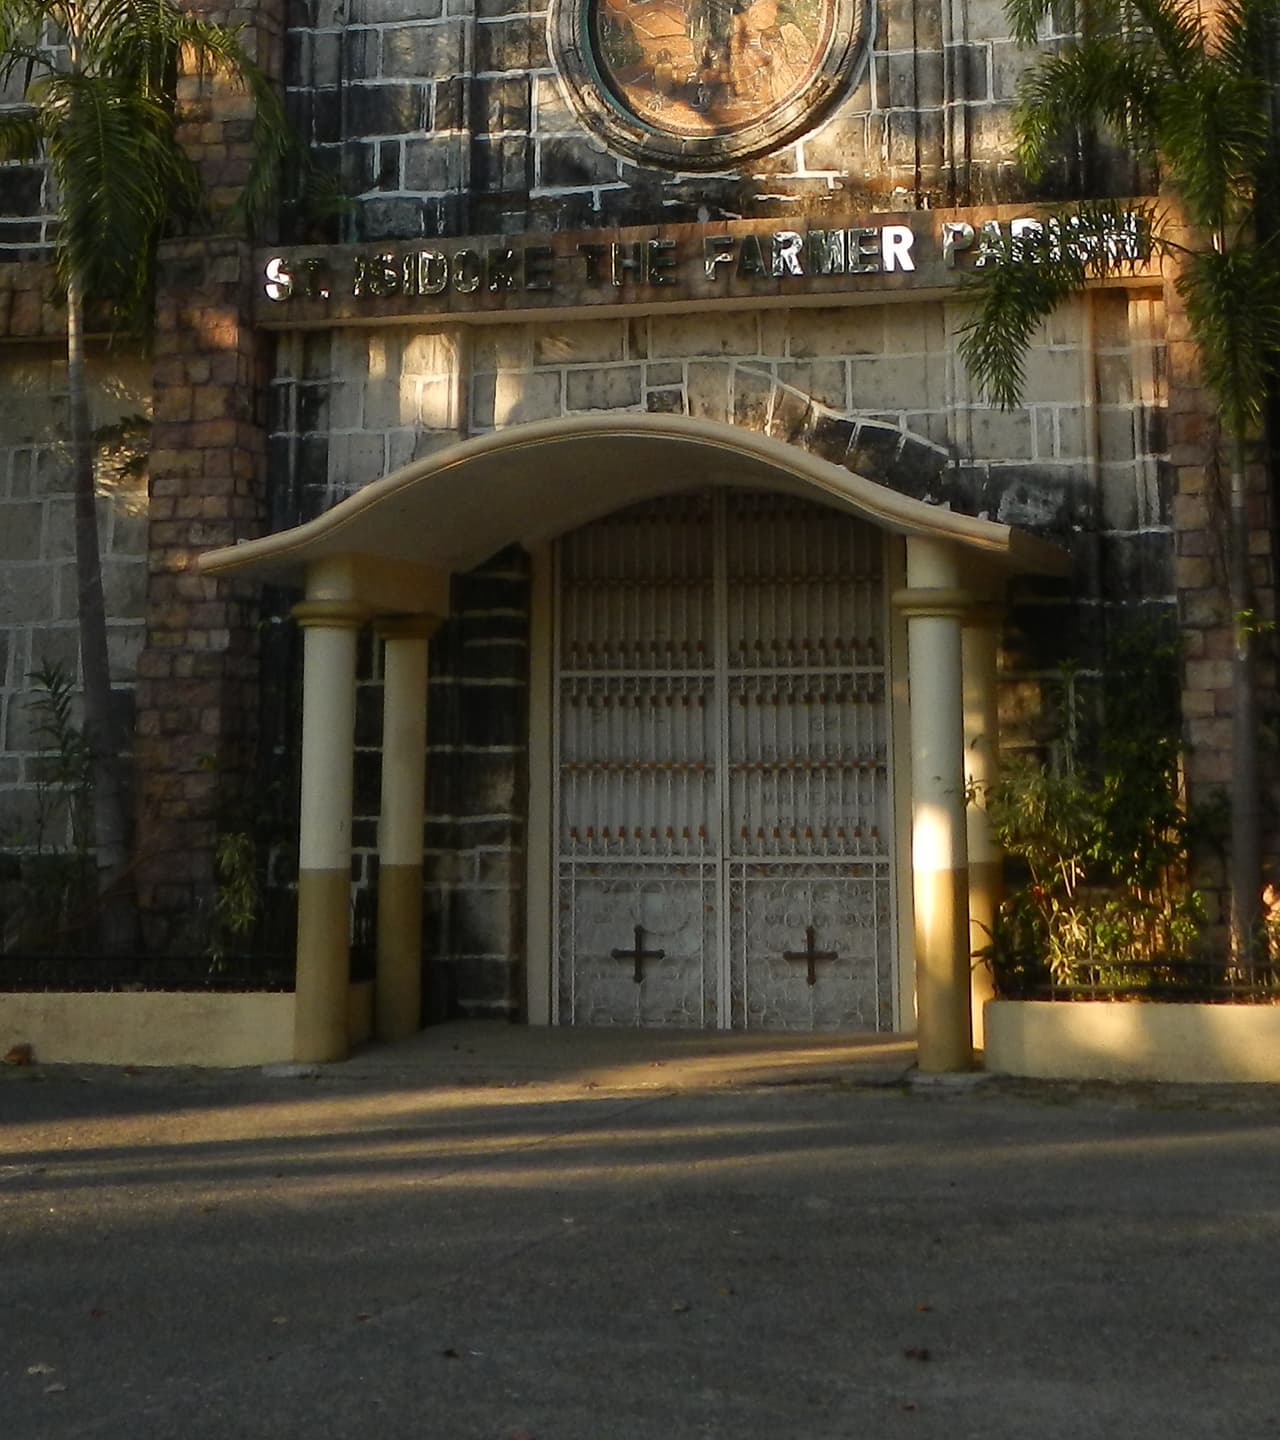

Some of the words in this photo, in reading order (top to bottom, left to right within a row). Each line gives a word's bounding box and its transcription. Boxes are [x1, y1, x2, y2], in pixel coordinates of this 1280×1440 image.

[264, 257, 330, 301] ST.
[353, 247, 552, 296] ISIDORE
[576, 239, 677, 287] THE
[703, 225, 916, 281] FARMER
